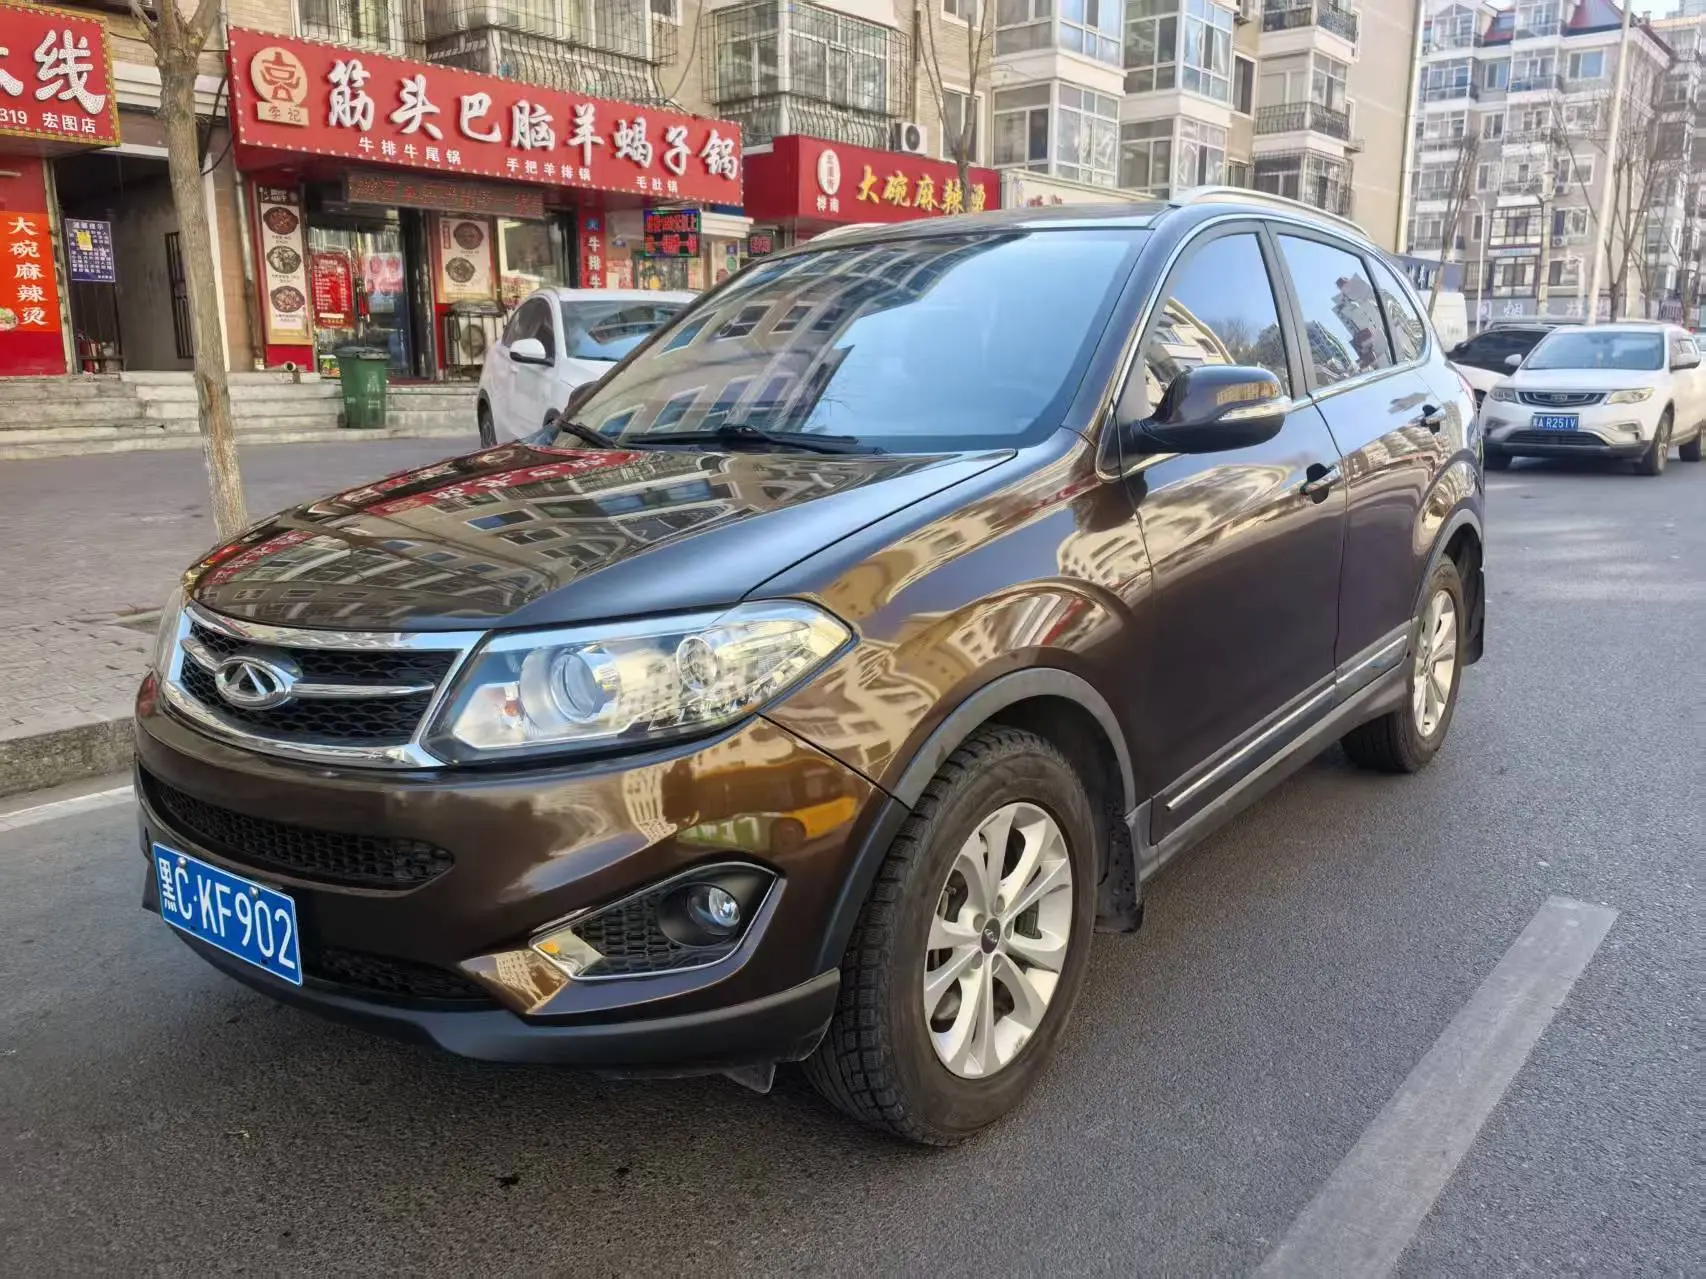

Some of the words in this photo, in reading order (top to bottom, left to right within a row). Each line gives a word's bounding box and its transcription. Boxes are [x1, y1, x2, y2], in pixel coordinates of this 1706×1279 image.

[42, 111, 96, 134] 宏图店
[327, 58, 739, 180] 筋头巴脑羊蝎子锅
[359, 136, 461, 165] 牛排牛尾锅
[506, 157, 591, 181] 手把羊排锅
[636, 175, 679, 193] 毛肚锅
[8, 216, 49, 326] 大碗麻辣烫
